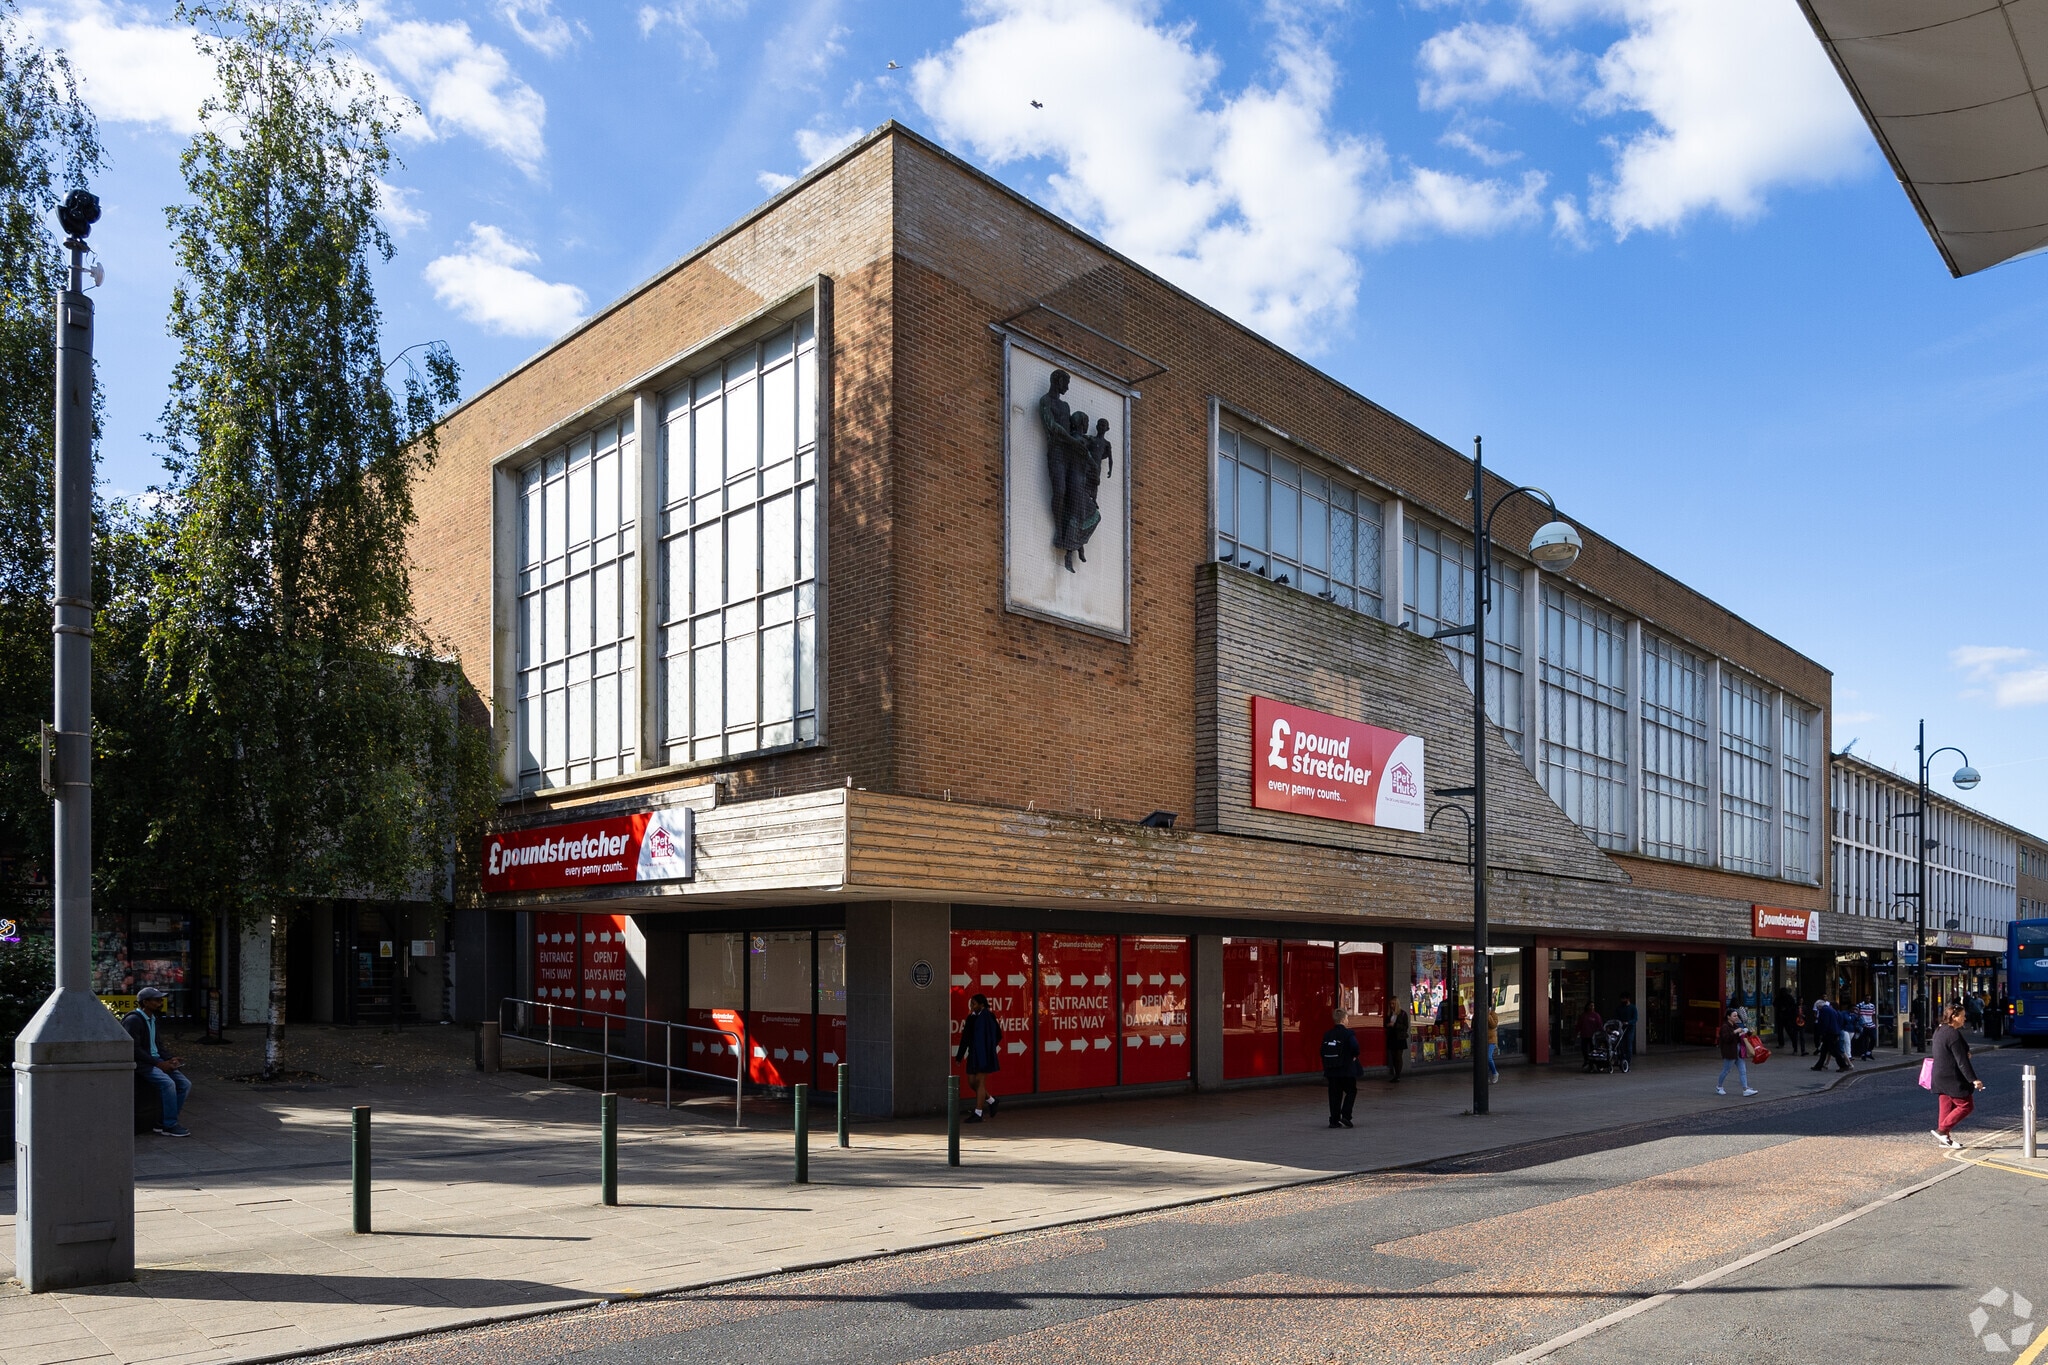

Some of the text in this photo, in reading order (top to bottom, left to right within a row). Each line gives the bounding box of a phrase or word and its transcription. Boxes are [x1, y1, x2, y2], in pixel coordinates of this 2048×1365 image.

[1294, 731, 1350, 759] pound
[1291, 753, 1372, 786] stretcher
[1396, 770, 1410, 784] Pet
[1268, 780, 1290, 795] every
[1291, 782, 1315, 799] penny
[1396, 782, 1410, 795] Hut
[655, 835, 667, 847] Pet
[654, 845, 668, 858] Hut
[565, 866, 581, 878] every
[582, 864, 601, 877] penny
[539, 951, 574, 964] ENTRANCE
[593, 951, 618, 964] OPEN 7
[541, 968, 572, 981] THIS WAY
[584, 968, 626, 982] DAYS A WEEK
[1461, 965, 1475, 978] SAL
[1004, 997, 1013, 1011] 7
[1049, 995, 1109, 1010] ENTRANCE
[1140, 994, 1166, 1007] OPEN
[1052, 1015, 1106, 1030] THIS WAY
[1125, 1013, 1152, 1027] DAYS
[1153, 1013, 1160, 1025] A
